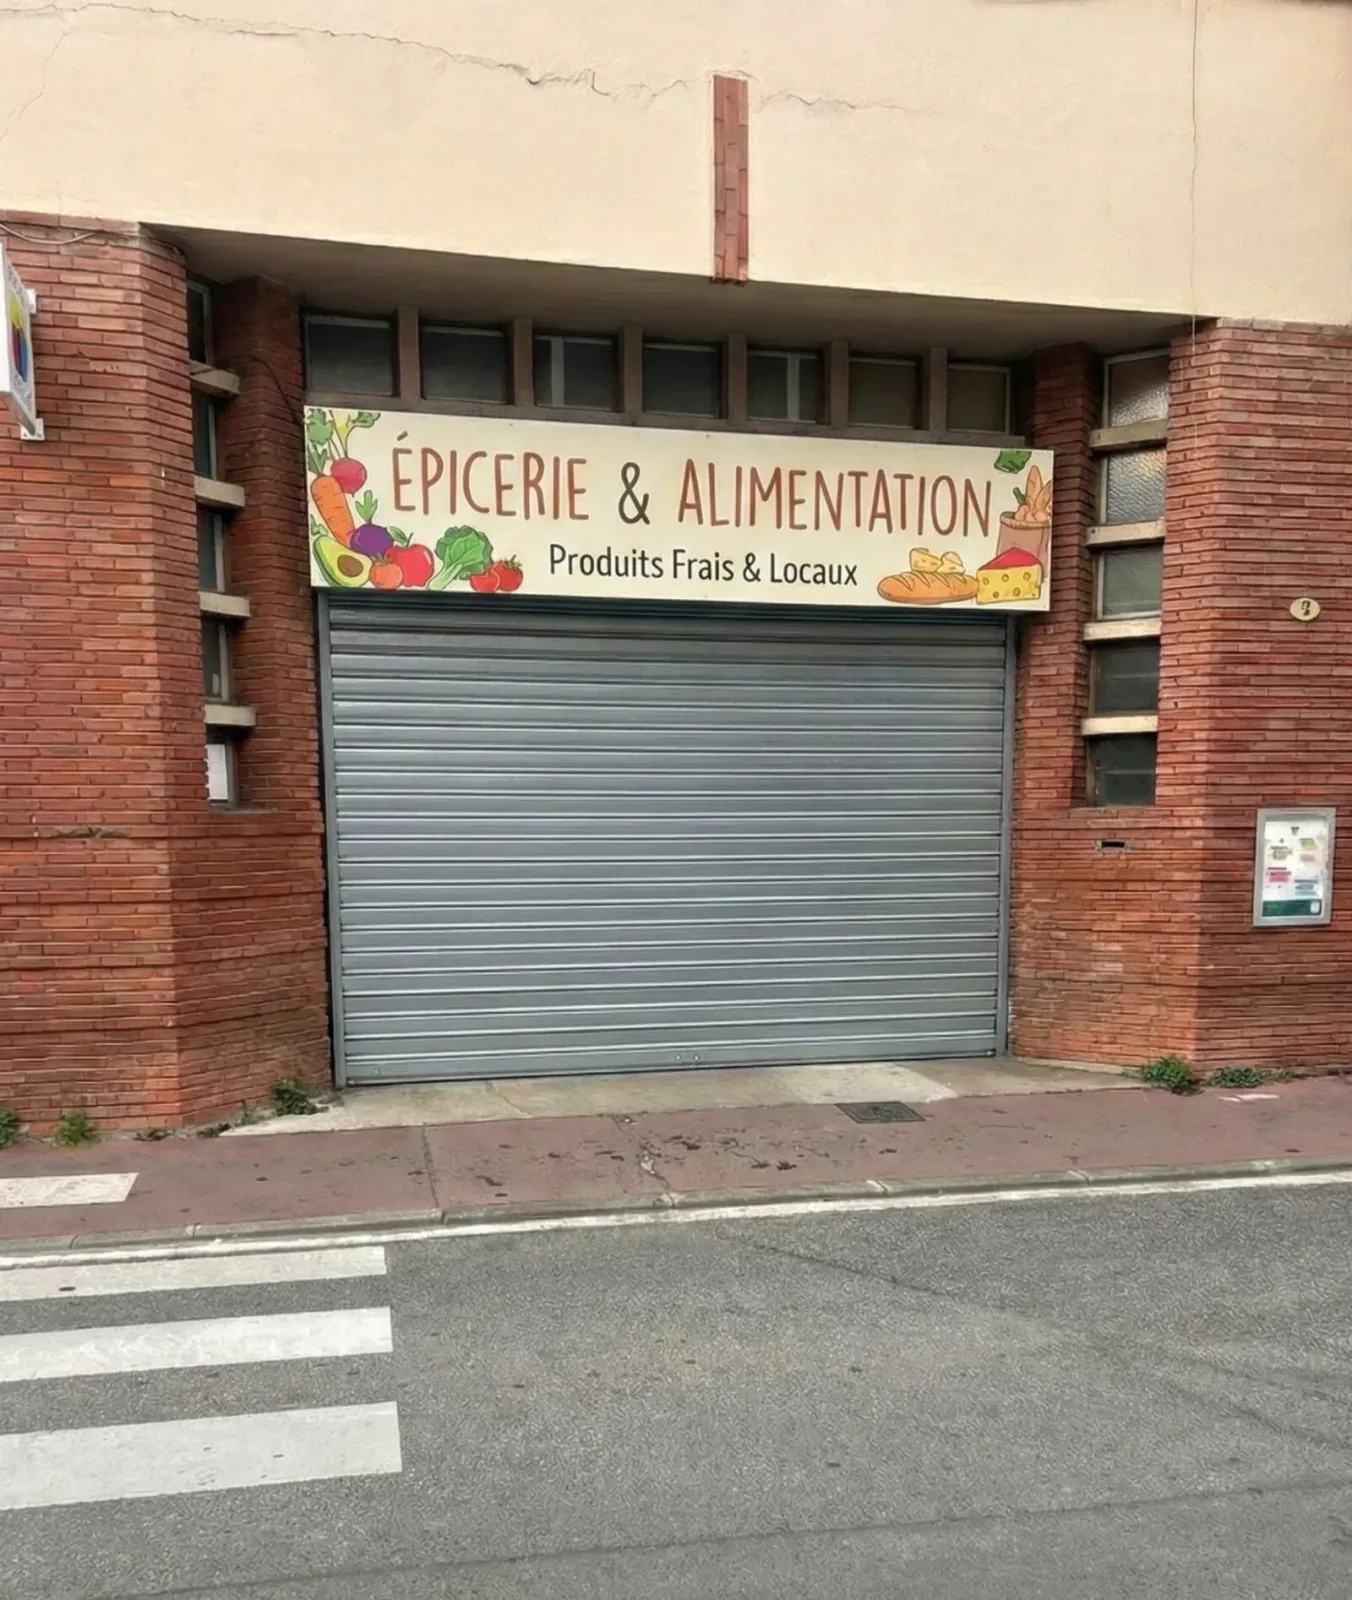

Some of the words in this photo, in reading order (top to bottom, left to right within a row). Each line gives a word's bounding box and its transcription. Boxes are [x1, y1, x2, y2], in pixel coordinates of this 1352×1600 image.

[392, 430, 590, 521] ÉPICERIE
[618, 461, 651, 525] &
[678, 456, 993, 538] ALIMENTATION
[549, 543, 664, 579] Produits
[672, 549, 735, 582] Frais
[742, 553, 762, 583] &
[770, 553, 858, 586] Locaux
